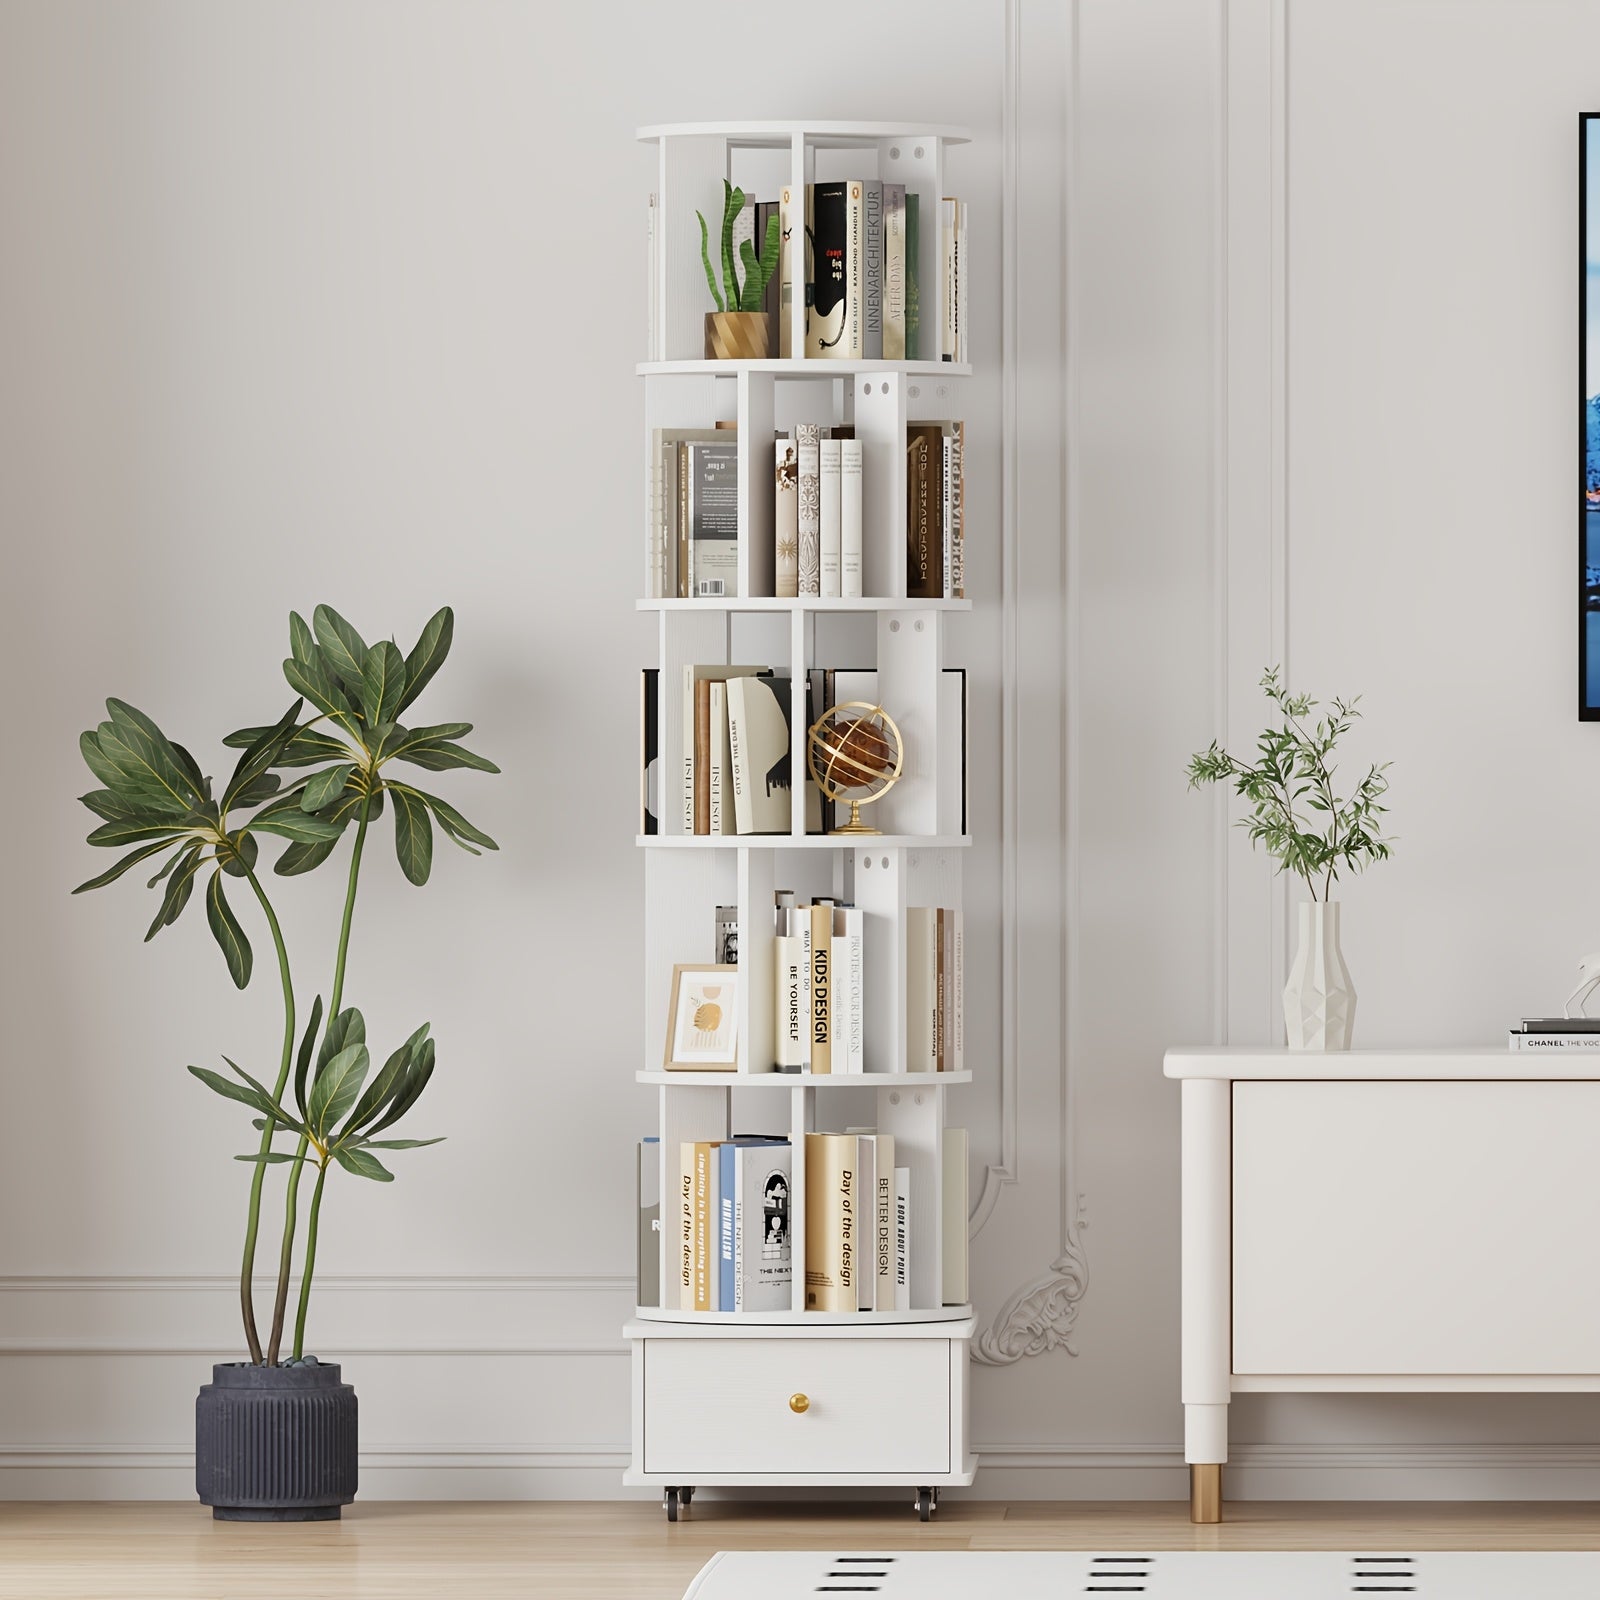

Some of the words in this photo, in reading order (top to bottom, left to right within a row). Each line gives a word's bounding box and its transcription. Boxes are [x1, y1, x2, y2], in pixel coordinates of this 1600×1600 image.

[867, 191, 879, 333] INNENARCHITEKTUR
[890, 255, 899, 285] DAYS
[890, 286, 900, 321] AFTER
[952, 429, 960, 529] ПАСТЕРНАК
[952, 534, 960, 588] БОРИС
[712, 766, 720, 795] FISH
[734, 764, 741, 774] OF
[712, 800, 720, 832] LOST
[789, 965, 798, 980] BE
[803, 961, 810, 972] TO
[815, 949, 828, 985] KIDS
[851, 936, 860, 985] PROTECT
[803, 978, 810, 991] DO
[851, 987, 860, 1011] OUR
[789, 983, 799, 1042] YOURSELF
[815, 988, 828, 1044] DESIGN
[834, 1015, 843, 1041] Design
[851, 1014, 860, 1054] DESIGN
[682, 1175, 692, 1198] Day
[697, 1153, 706, 1198] simplicity
[841, 1170, 852, 1196] Day
[683, 1203, 692, 1218] of
[698, 1200, 706, 1209] is
[842, 1199, 853, 1215] of
[879, 1178, 889, 1223] BETTER
[897, 1204, 905, 1225] BOOK
[683, 1219, 692, 1241] the
[722, 1198, 732, 1261] MINIMALISM
[842, 1217, 852, 1240] the
[897, 1229, 905, 1254] ABOUT
[697, 1222, 706, 1270] everything
[879, 1228, 889, 1276] DESIGN
[682, 1245, 692, 1287] design
[698, 1272, 705, 1284] we
[841, 1243, 853, 1288] design
[897, 1257, 905, 1286] POINTS
